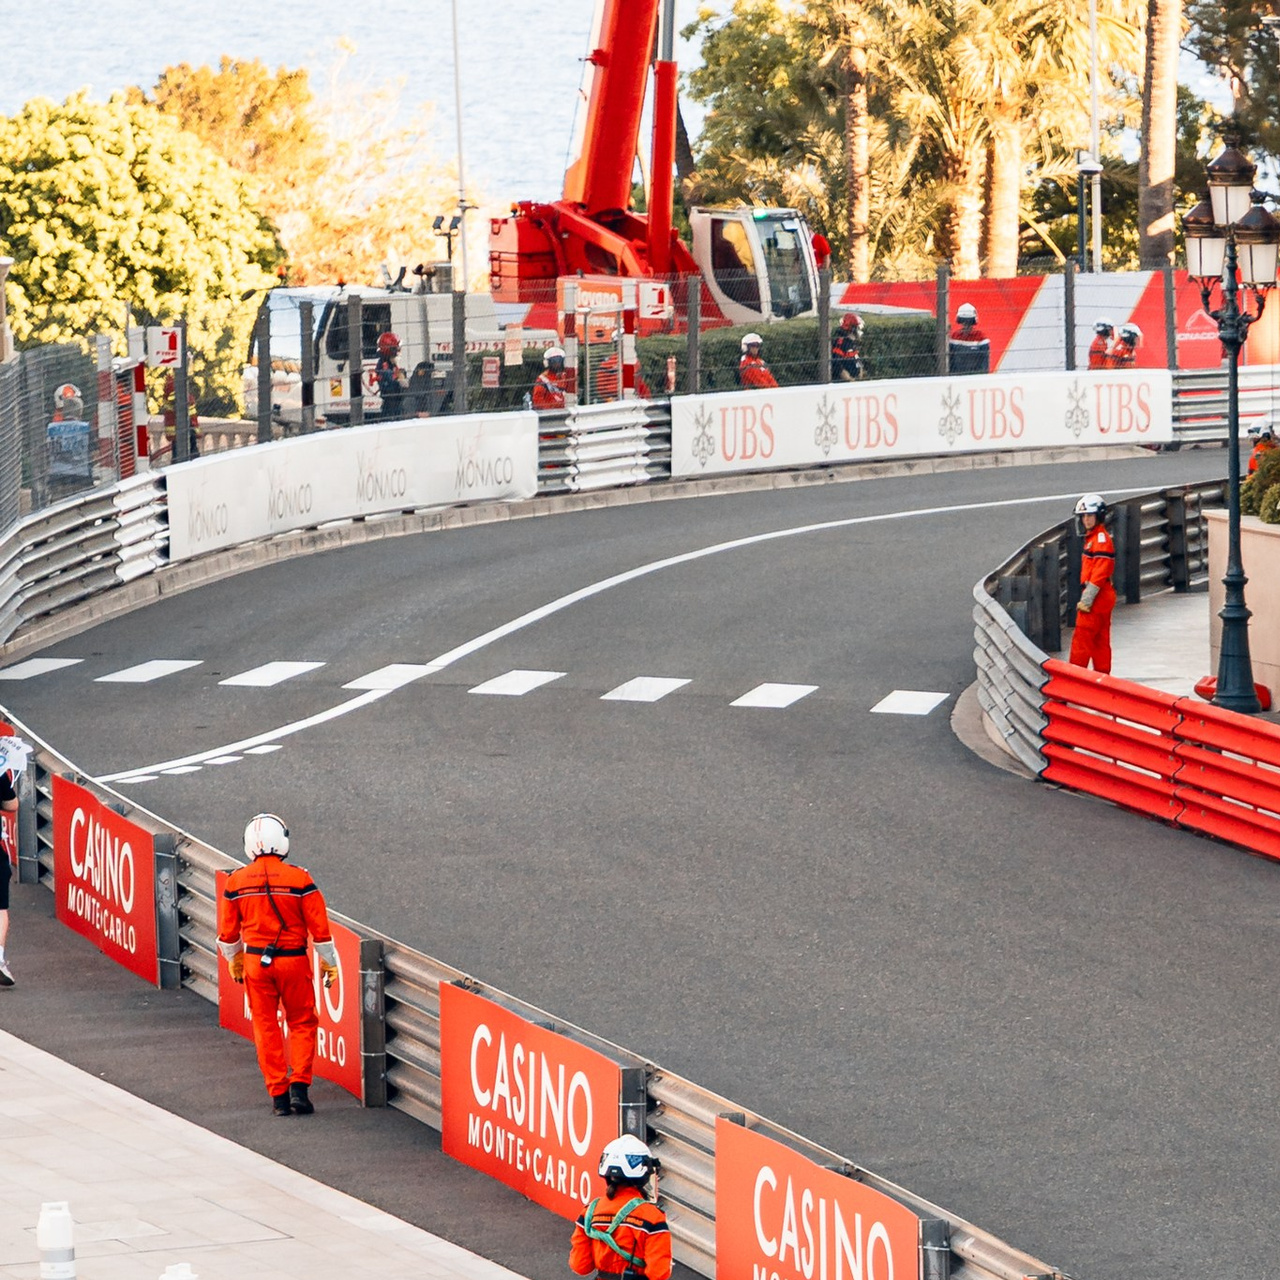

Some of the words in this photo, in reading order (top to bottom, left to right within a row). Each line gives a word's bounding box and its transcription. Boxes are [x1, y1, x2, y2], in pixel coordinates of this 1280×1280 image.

[719, 403, 775, 462] UBS
[843, 393, 899, 451] UBS
[968, 386, 1026, 442] UBS
[1094, 382, 1152, 435] UBS
[357, 468, 407, 504] MONACO
[454, 456, 513, 490] MONACO
[268, 482, 312, 522] MONACO
[69, 807, 134, 915] CASINO
[317, 1026, 346, 1067] RLO
[470, 1023, 593, 1156] CASINO
